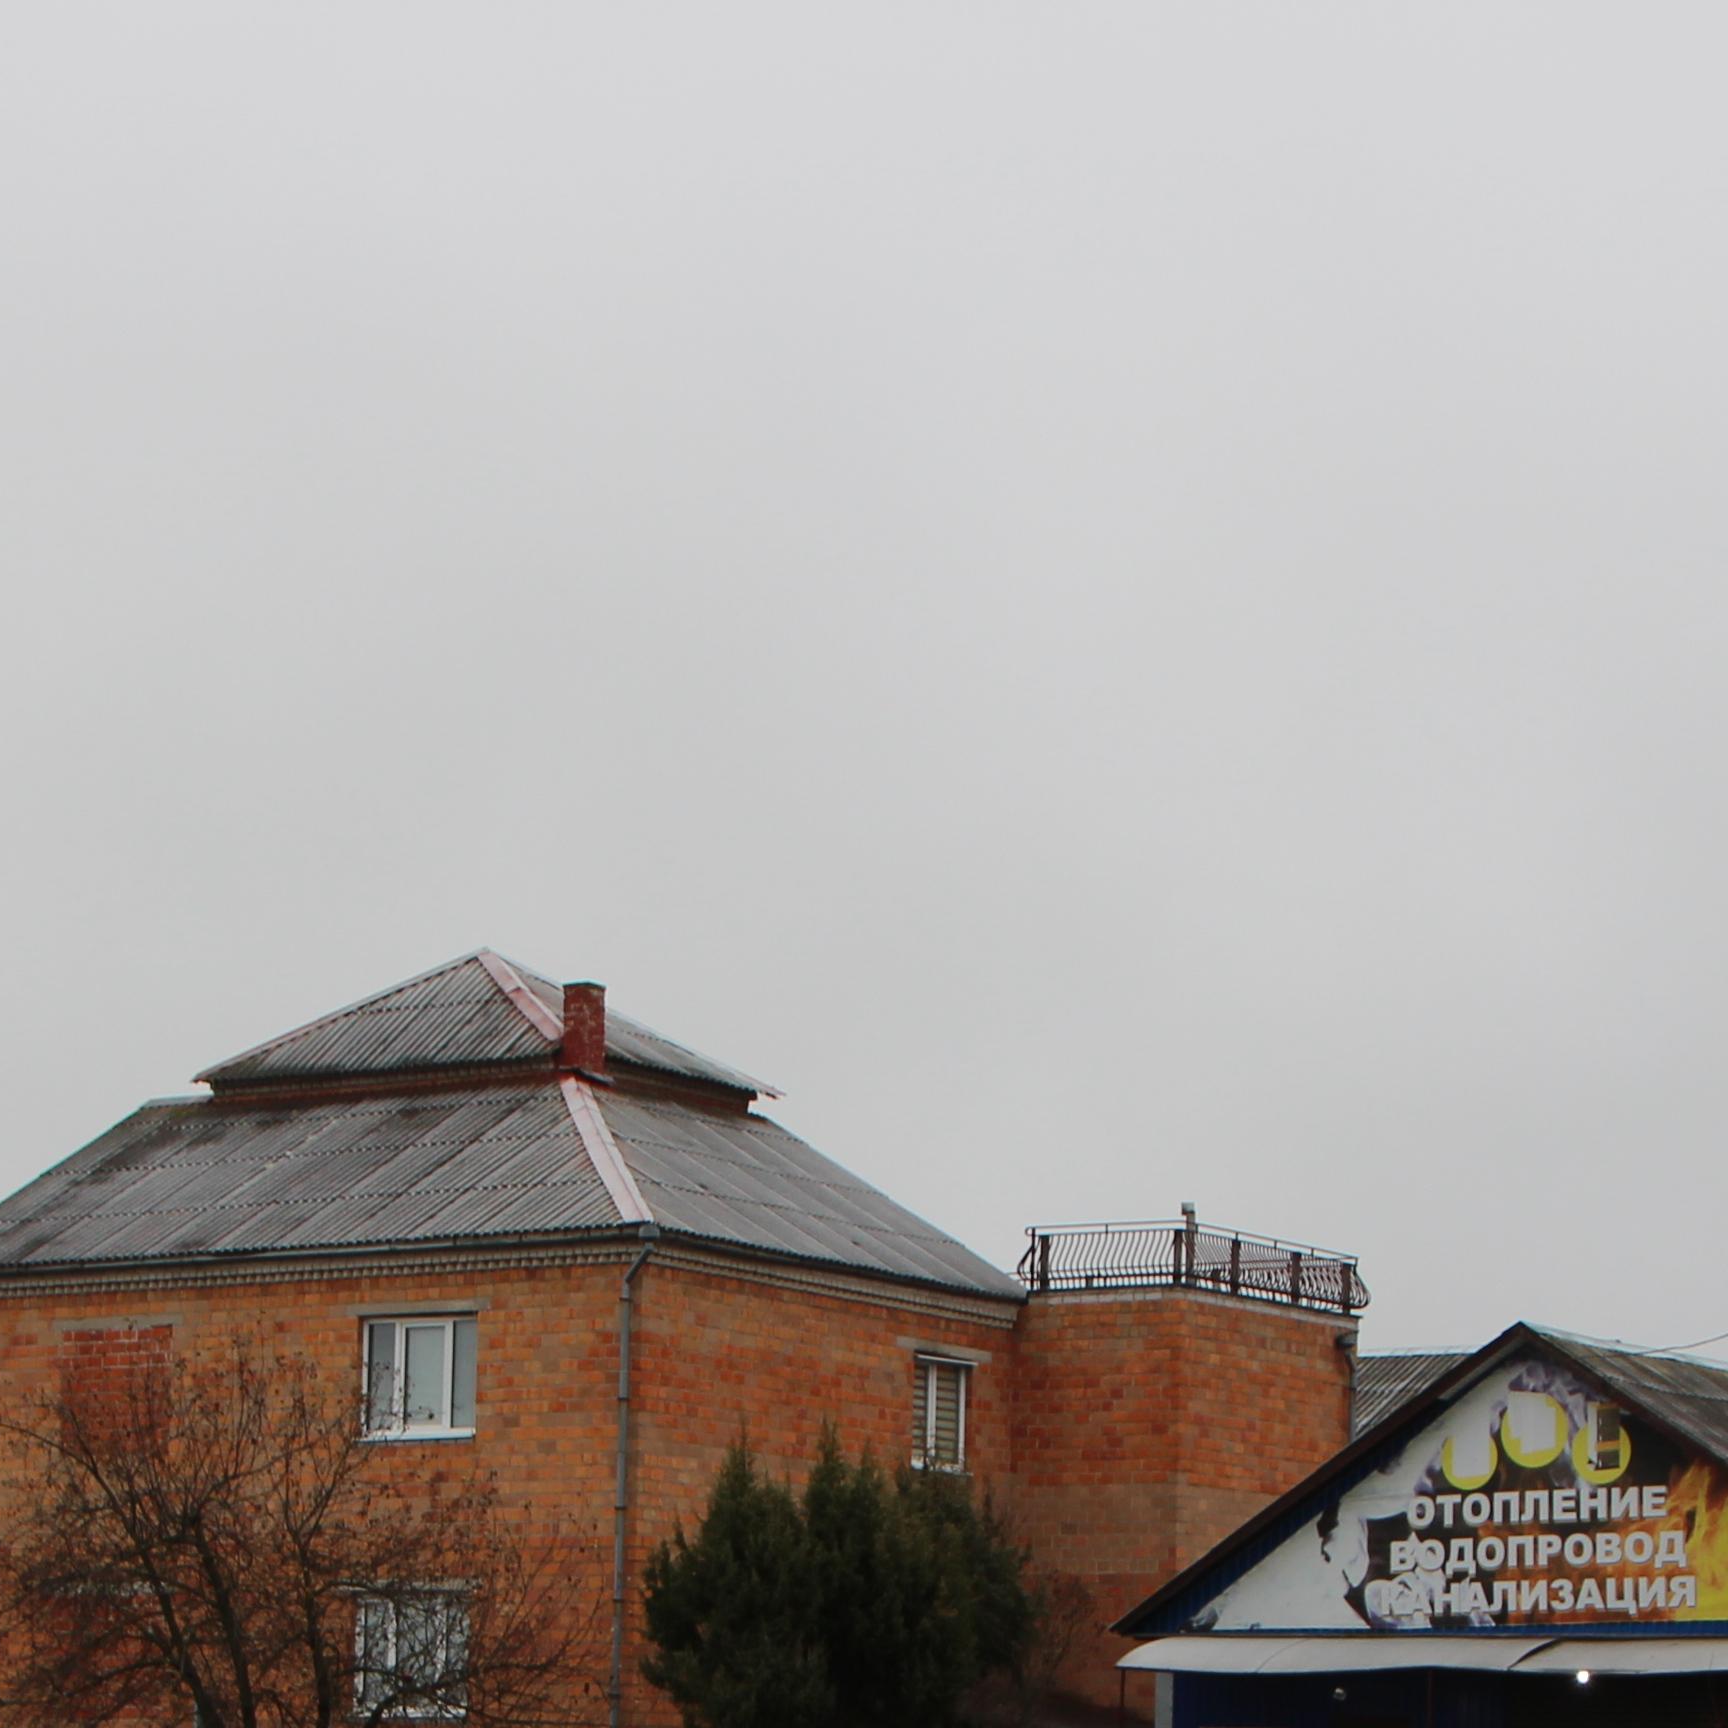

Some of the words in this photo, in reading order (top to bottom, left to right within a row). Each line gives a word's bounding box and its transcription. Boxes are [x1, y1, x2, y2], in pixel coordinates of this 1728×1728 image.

[1407, 1485, 1668, 1529] ОТОПЛЕНИЕ
[1390, 1530, 1688, 1578] ВОДОПРОВОД
[1382, 1575, 1697, 1616] КАНАЛИЗАЦИЯ
